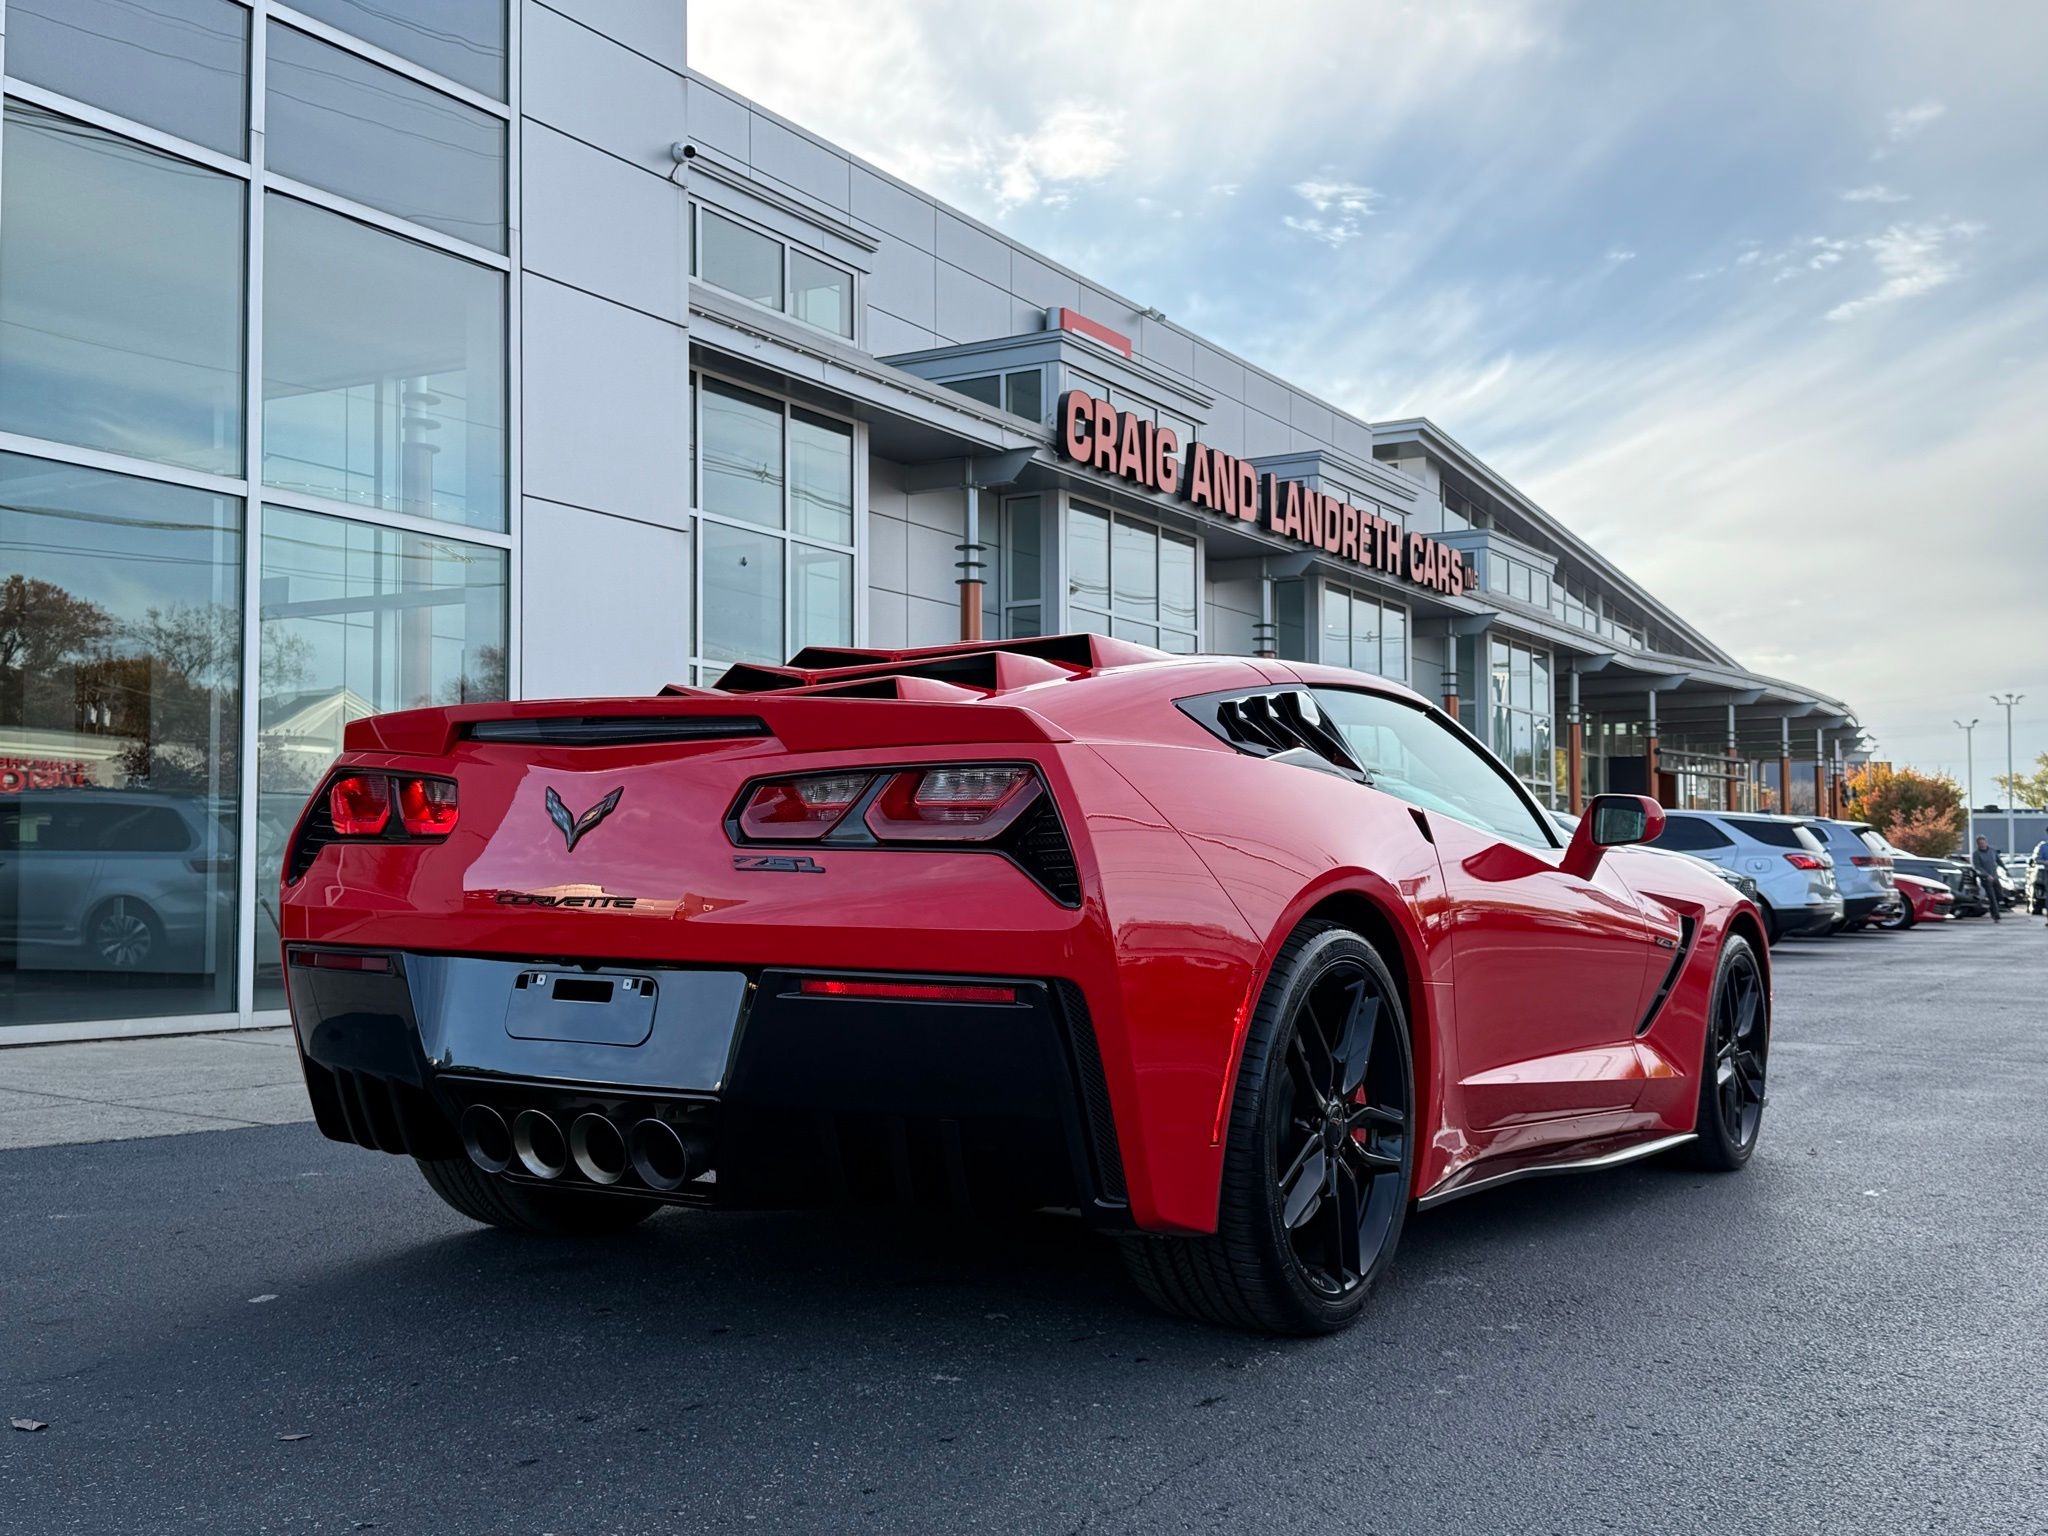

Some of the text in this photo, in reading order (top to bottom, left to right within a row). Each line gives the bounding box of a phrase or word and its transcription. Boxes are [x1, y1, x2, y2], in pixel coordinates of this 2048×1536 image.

[1063, 389, 1178, 495] CRAIG
[1189, 441, 1258, 523] AND
[1267, 471, 1403, 577] LANDRETH
[1408, 531, 1463, 597] CARS
[732, 855, 826, 873] Z51
[495, 893, 637, 908] CORVETTE
